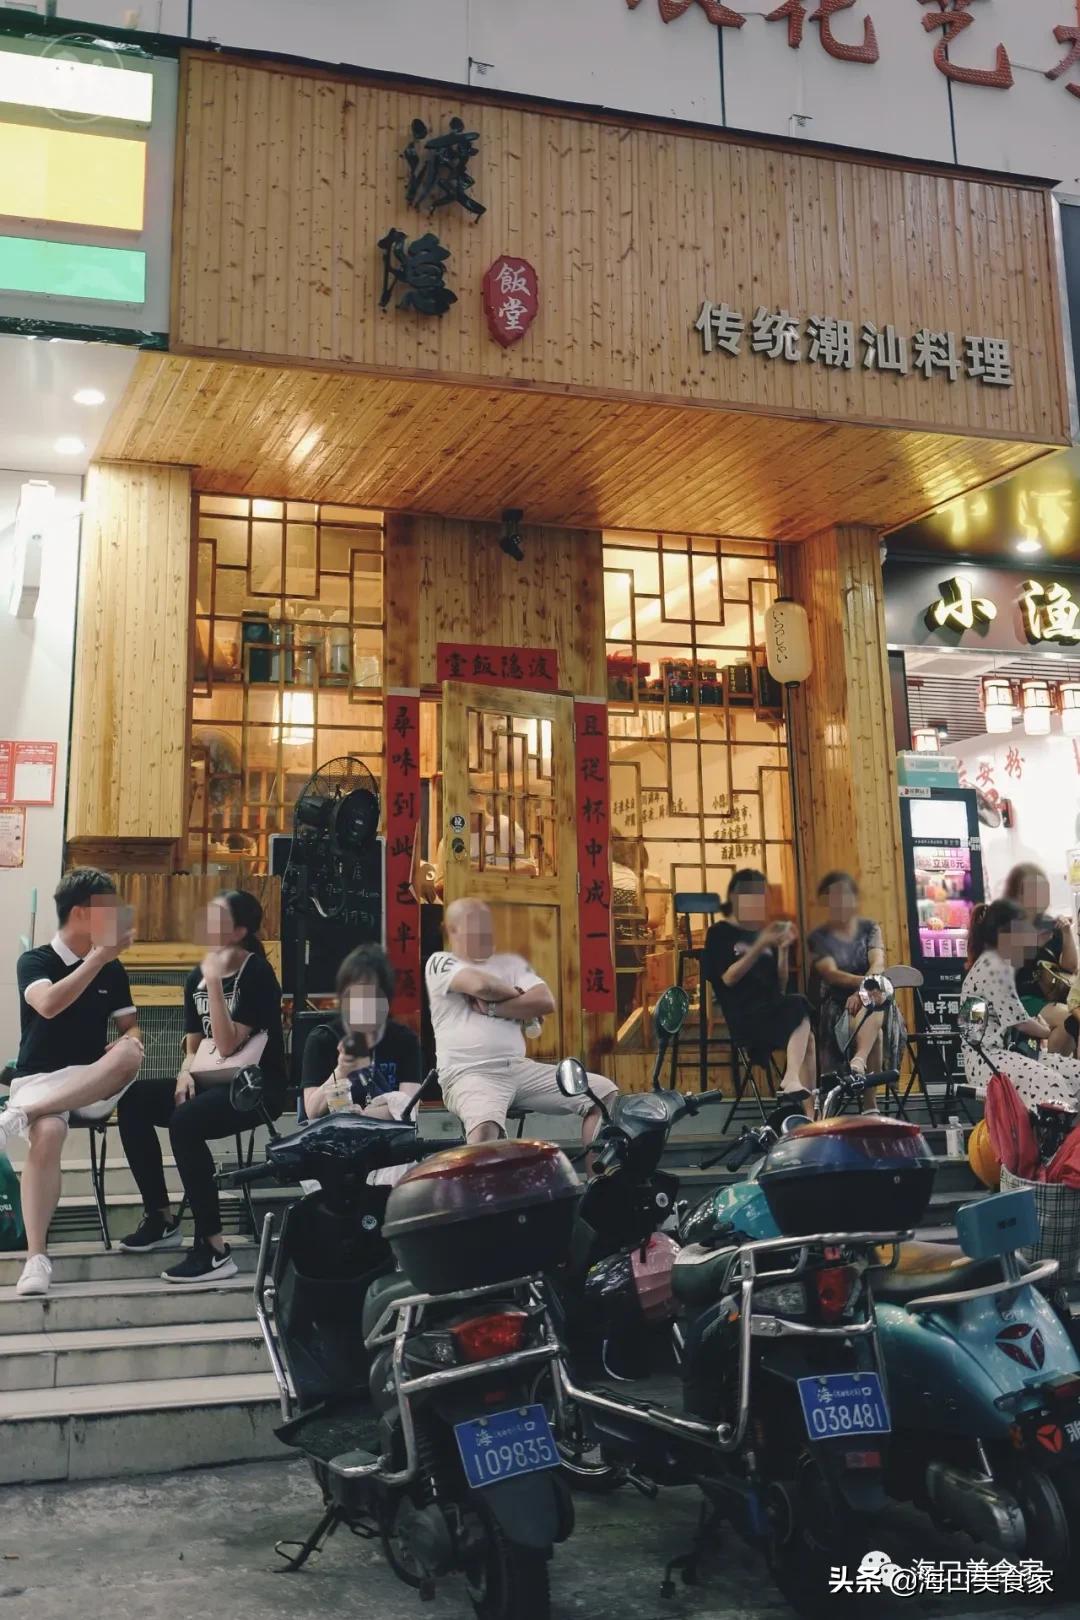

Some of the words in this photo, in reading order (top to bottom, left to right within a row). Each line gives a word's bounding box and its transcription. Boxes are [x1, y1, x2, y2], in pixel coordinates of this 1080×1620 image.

[695, 300, 1015, 388] 传统潮汕料理
[924, 1001, 959, 1015] 电子烟
[812, 1403, 883, 1433] 038481
[474, 1436, 552, 1480] 109835
